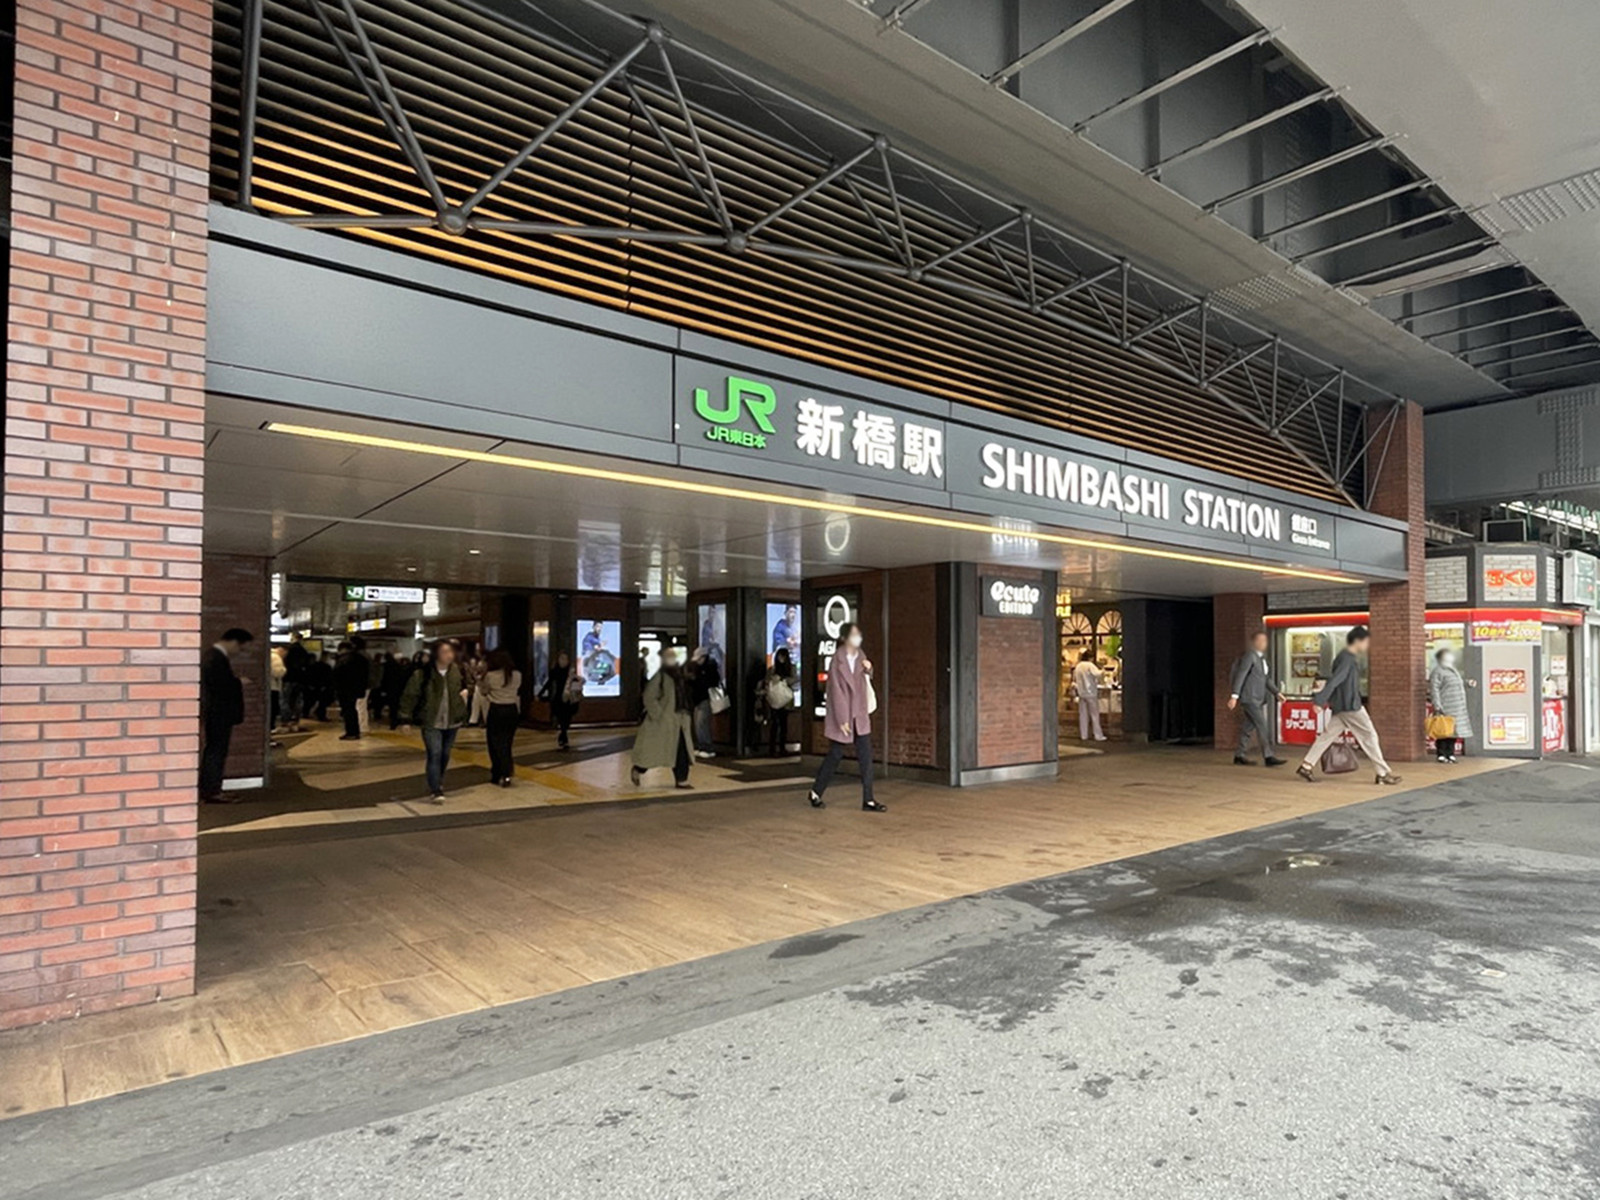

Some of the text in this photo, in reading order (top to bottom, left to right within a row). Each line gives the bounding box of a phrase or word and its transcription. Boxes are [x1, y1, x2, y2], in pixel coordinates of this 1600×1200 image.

[695, 375, 777, 434] JR
[706, 425, 766, 449] JR東日本
[796, 397, 943, 479] 新橋駅
[982, 442, 1281, 541] SHIMBASHI STATION
